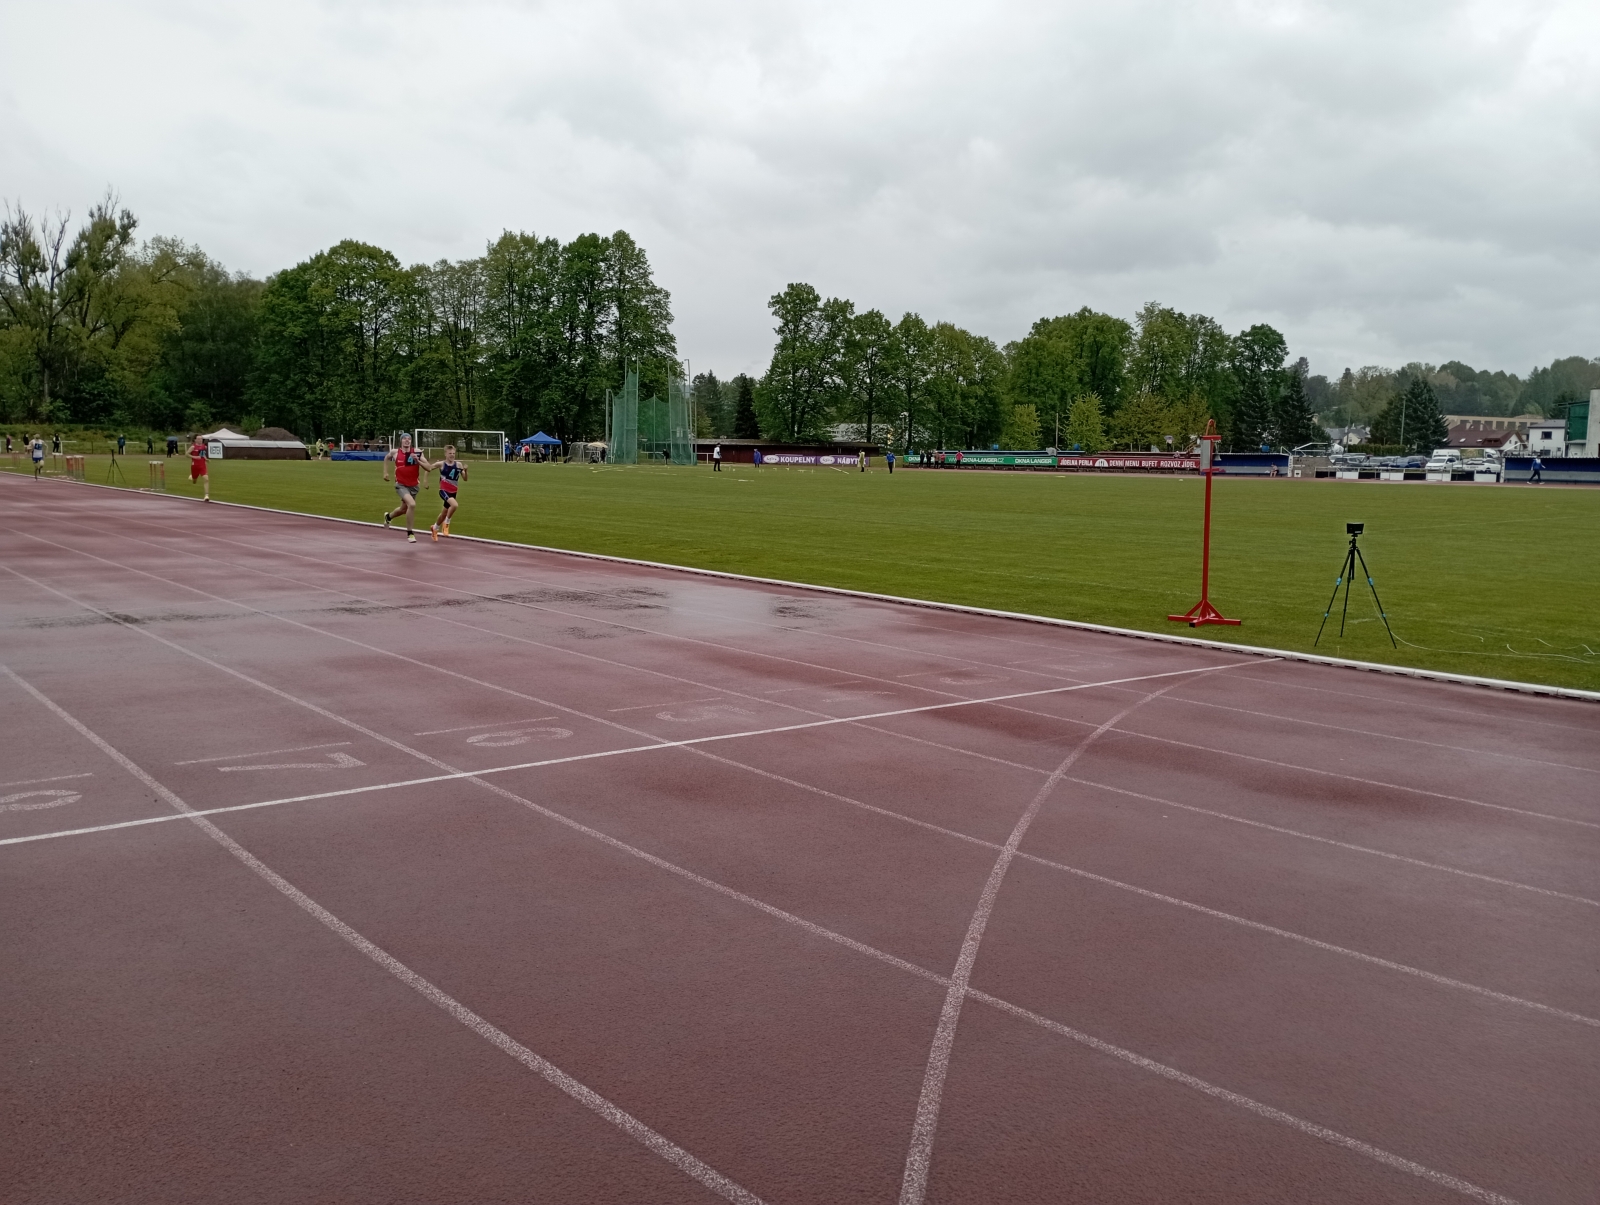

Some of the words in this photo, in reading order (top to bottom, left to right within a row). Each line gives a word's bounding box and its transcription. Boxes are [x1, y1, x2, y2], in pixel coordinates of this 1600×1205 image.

[1060, 458, 1078, 466] JÍDELNA
[1109, 459, 1124, 467] DENNÍ
[1181, 460, 1196, 468] JÍDEL
[217, 752, 367, 772] 7
